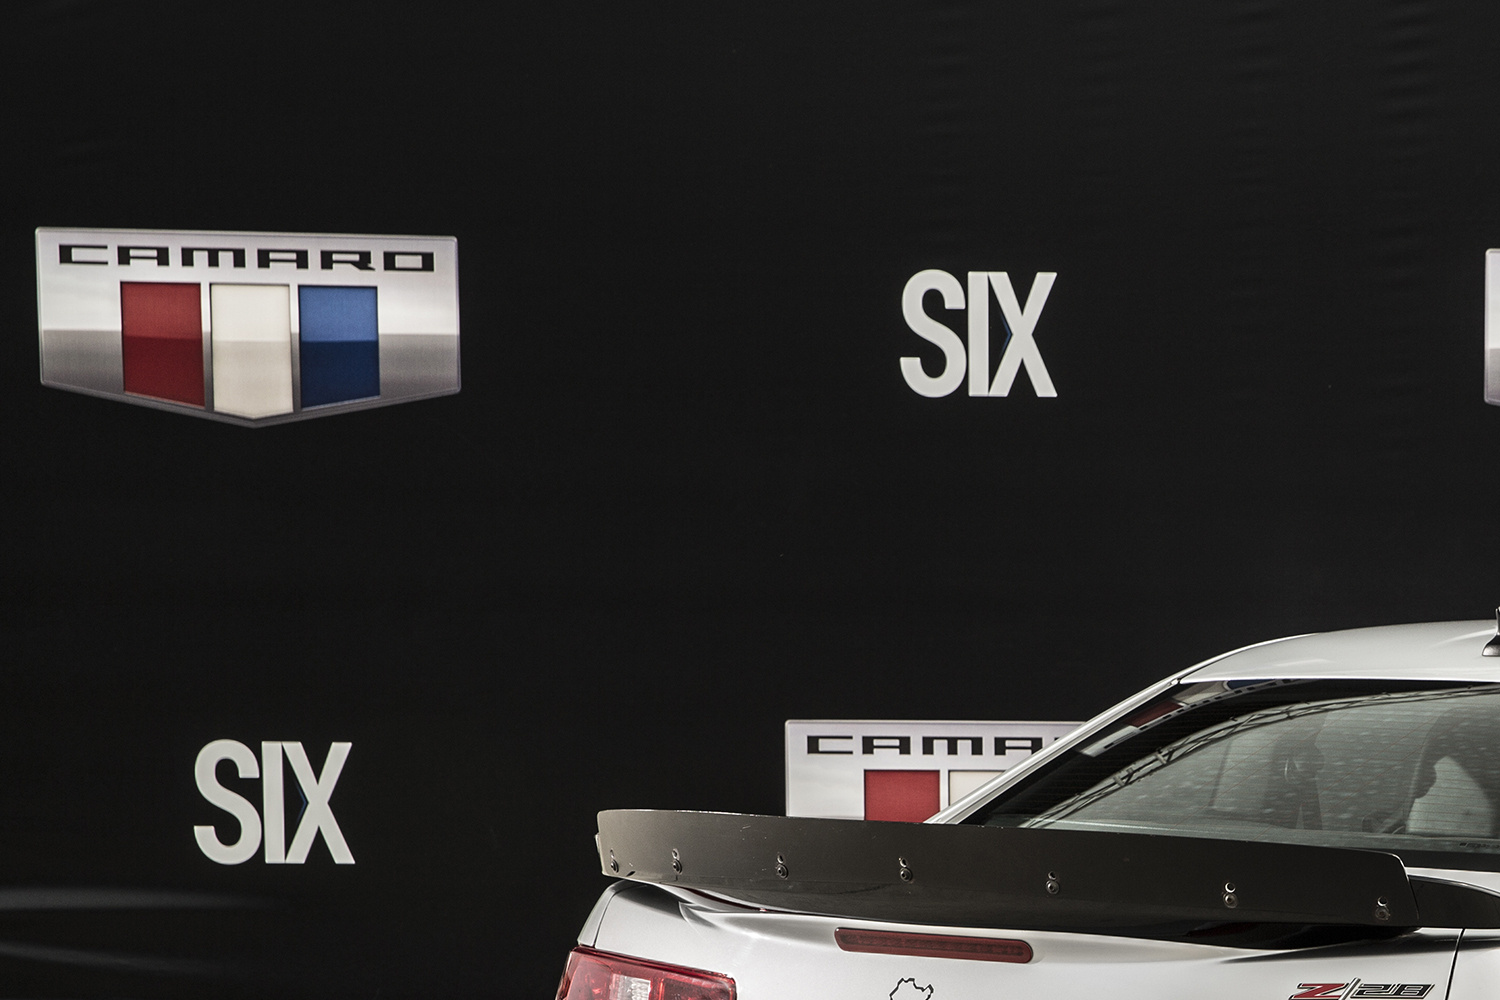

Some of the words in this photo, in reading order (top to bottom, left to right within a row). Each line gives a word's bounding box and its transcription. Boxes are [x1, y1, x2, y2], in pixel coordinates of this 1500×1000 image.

[59, 243, 434, 273] CAMARO
[899, 269, 1058, 398] SIX
[806, 735, 1061, 756] CAMA
[193, 738, 356, 865] SIX
